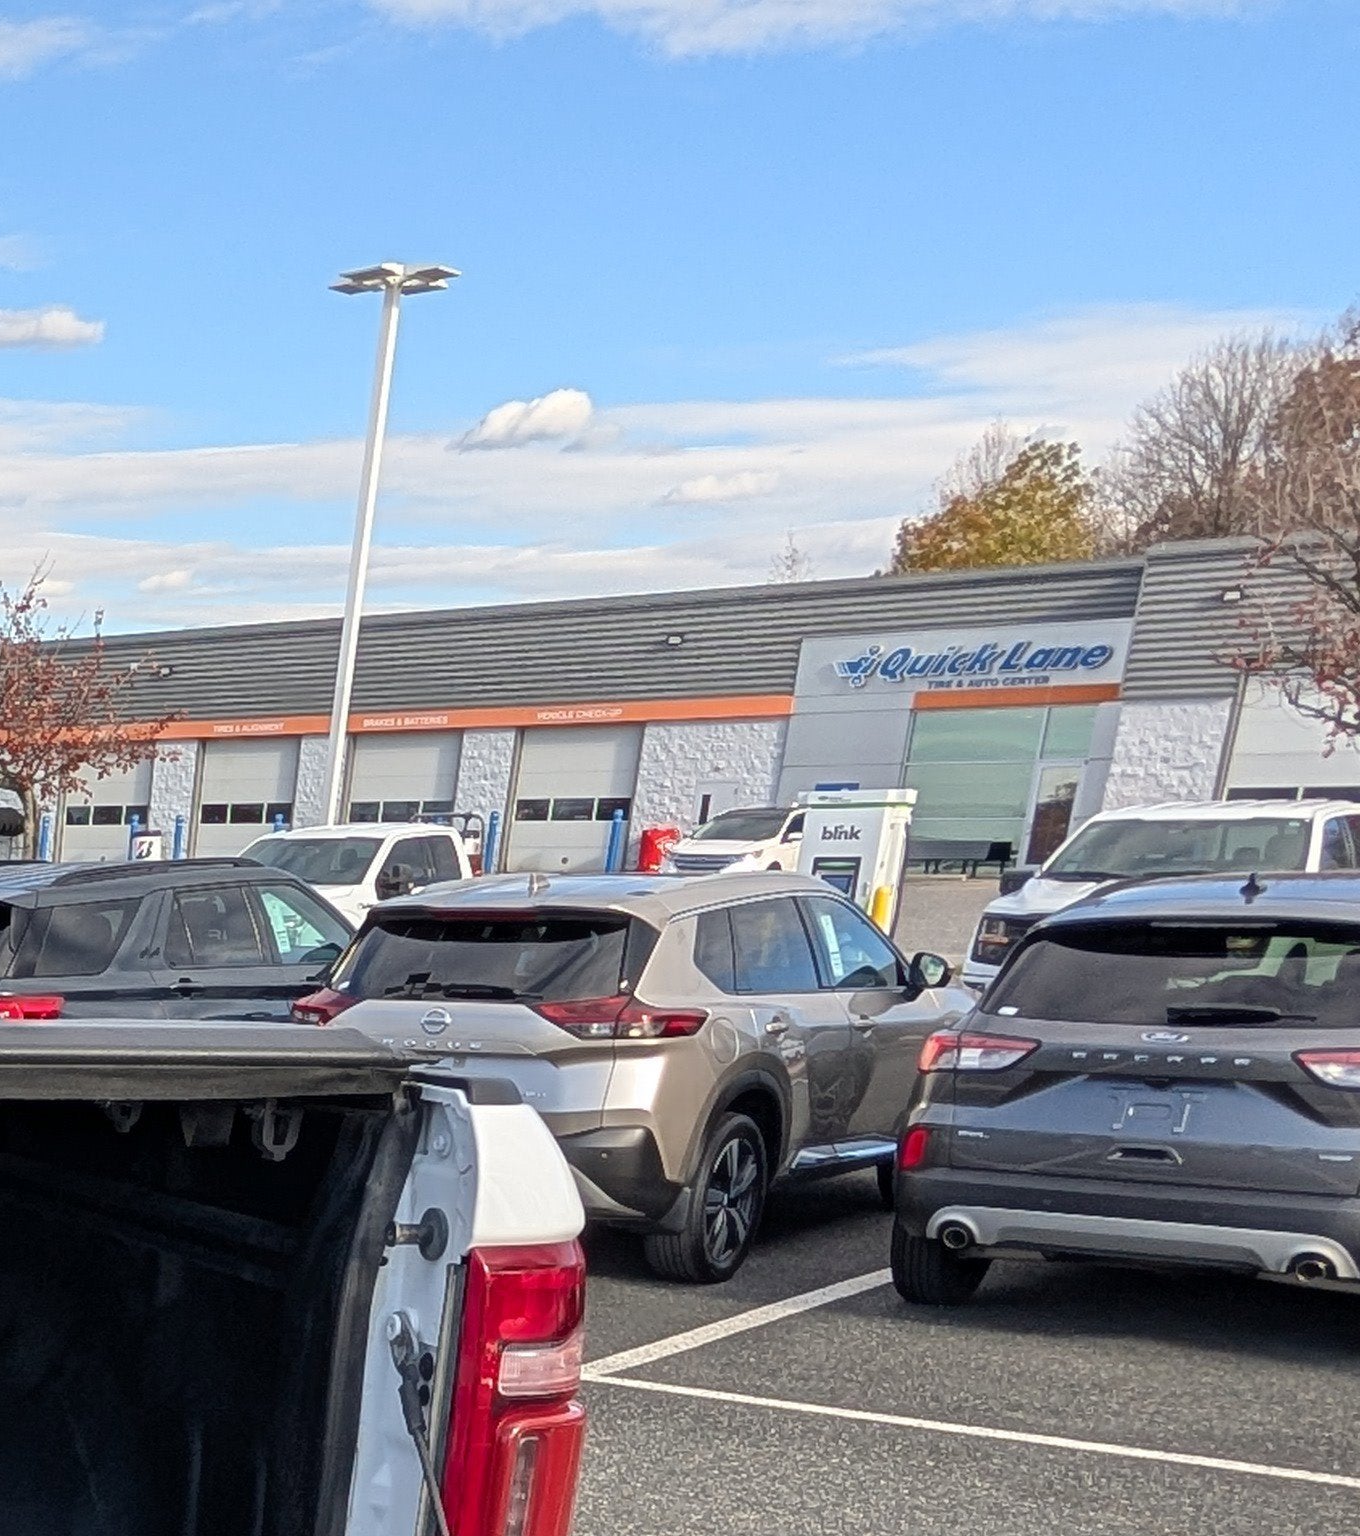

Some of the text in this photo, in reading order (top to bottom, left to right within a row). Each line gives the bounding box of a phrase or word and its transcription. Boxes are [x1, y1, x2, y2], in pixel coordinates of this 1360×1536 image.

[879, 640, 1113, 681] Quick Lane
[927, 676, 1050, 689] TIRE & AUTO CENTER
[363, 715, 448, 727] BRAKES & BATTERIES
[821, 824, 862, 840] blink
